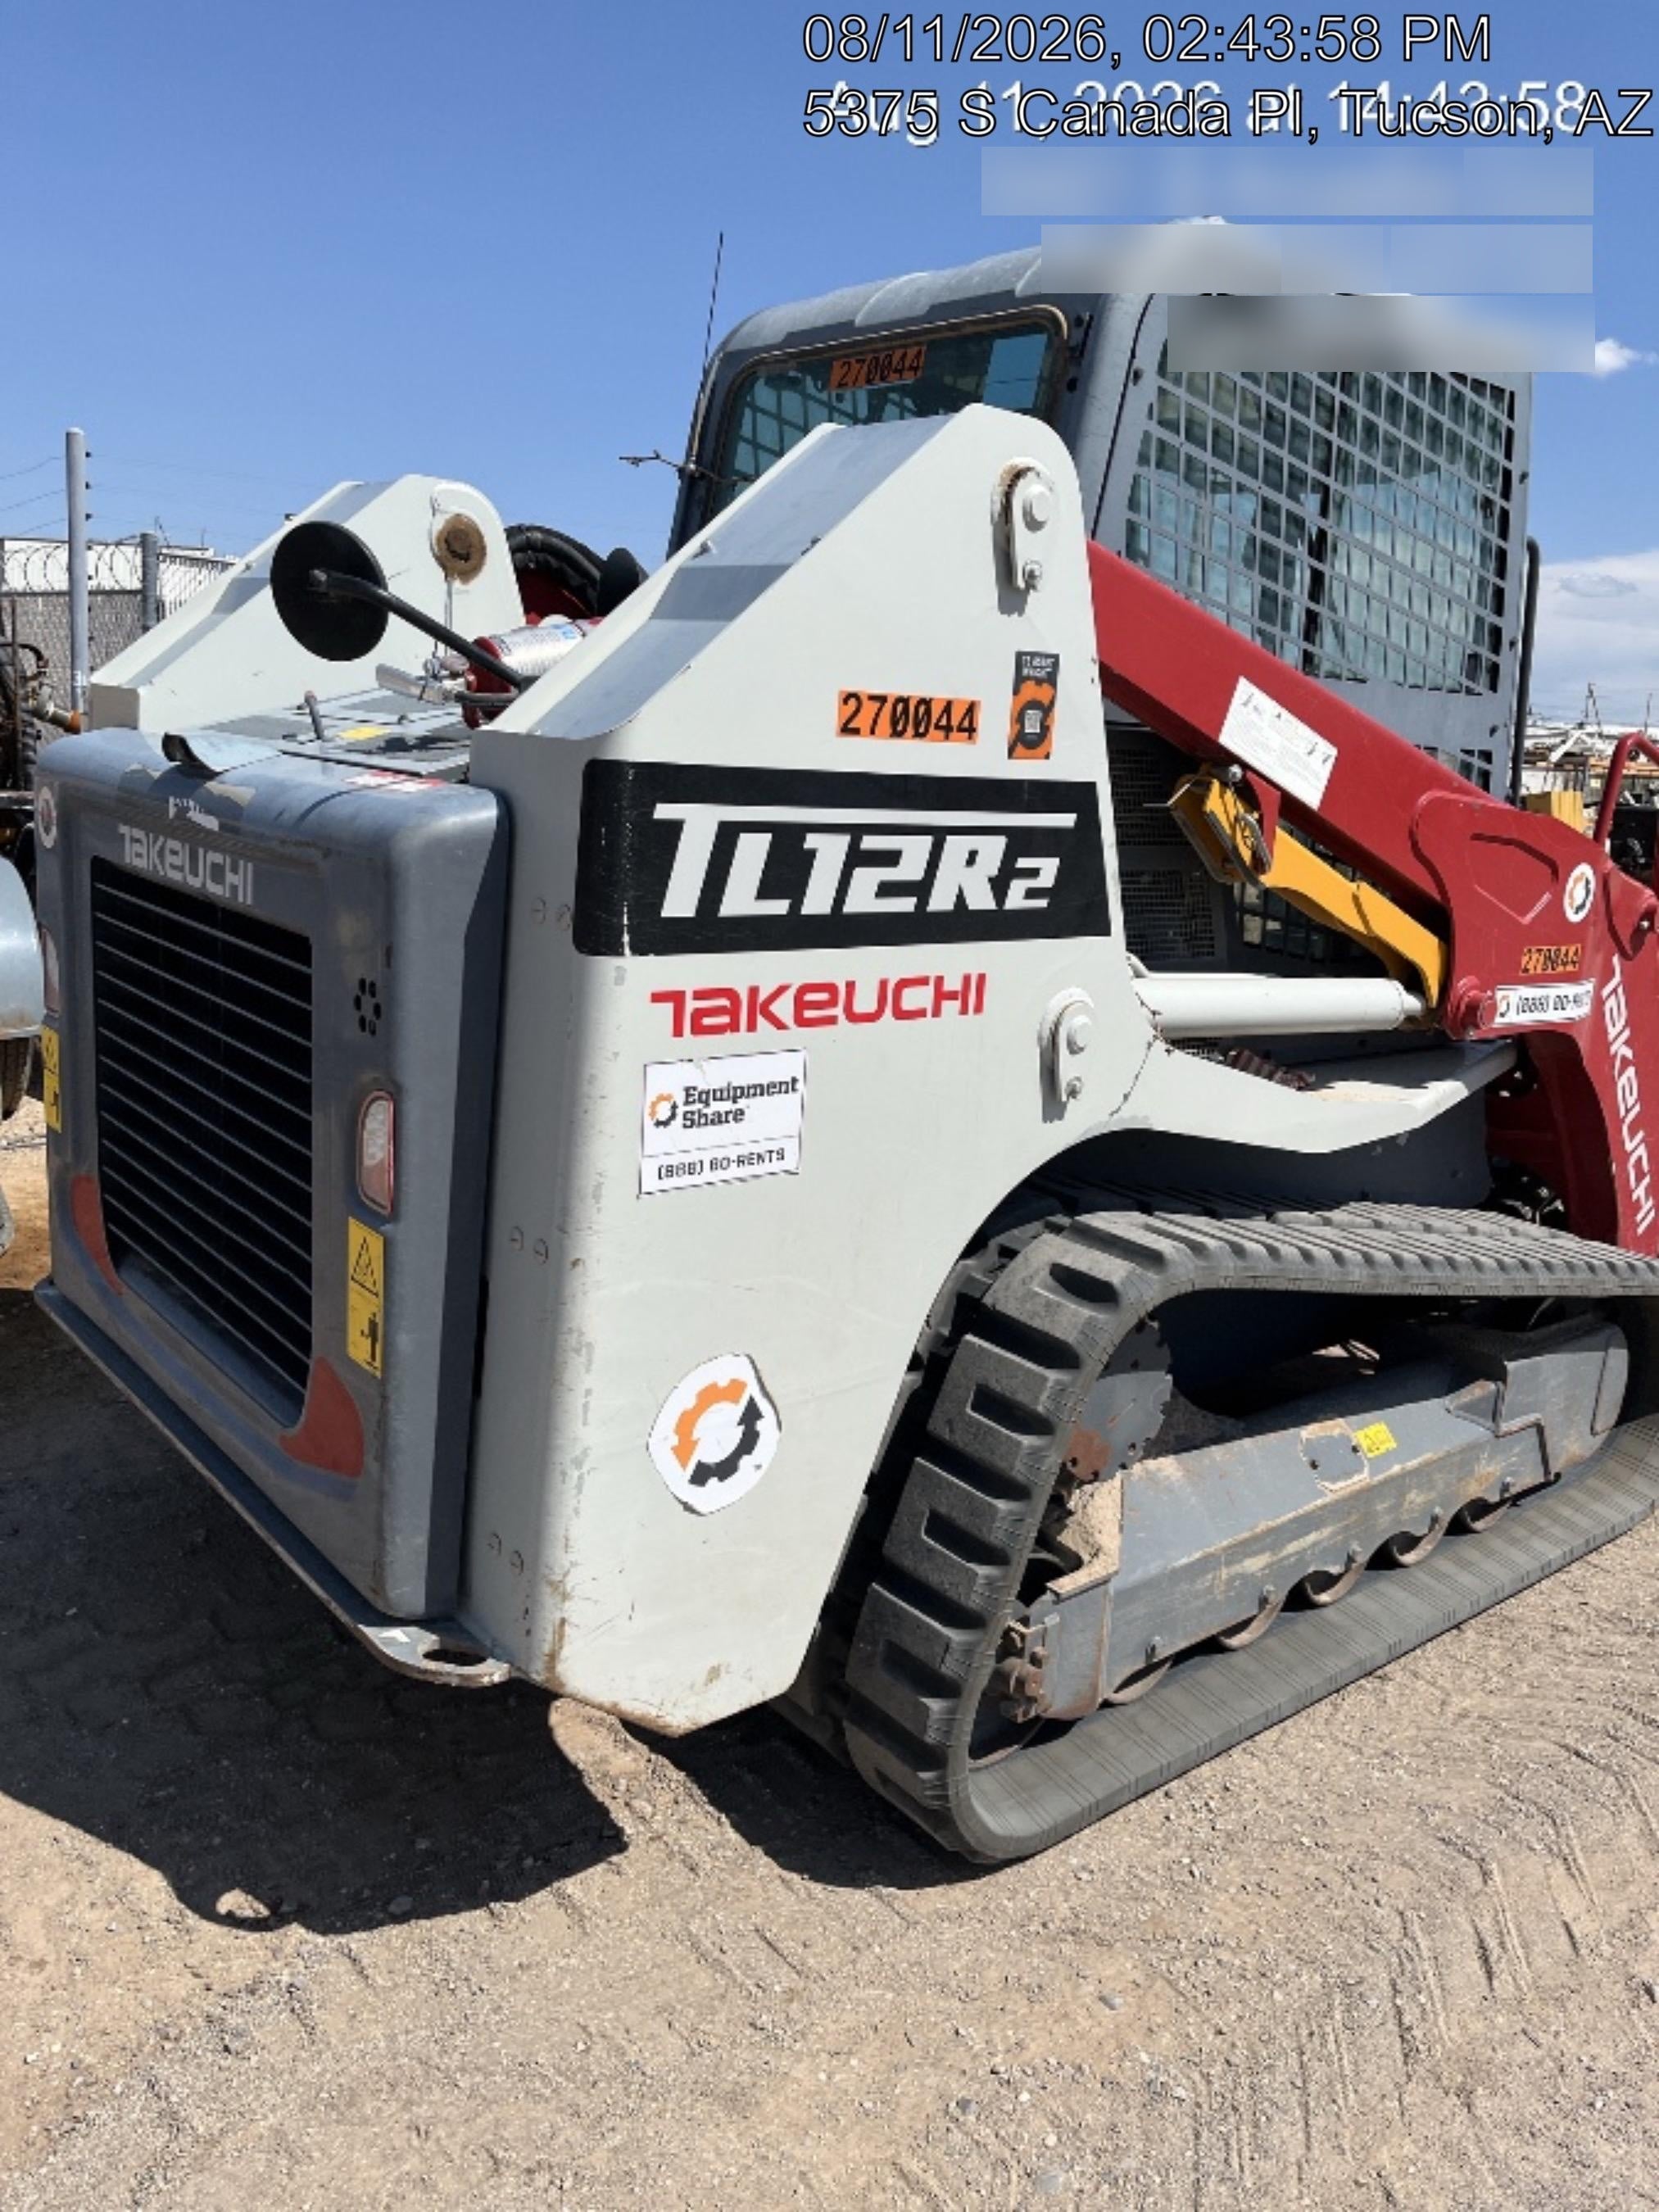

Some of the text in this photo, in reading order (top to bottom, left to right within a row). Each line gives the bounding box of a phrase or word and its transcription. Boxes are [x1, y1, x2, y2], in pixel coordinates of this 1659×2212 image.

[836, 347, 923, 388] 270044
[841, 691, 977, 741] 270044
[117, 823, 255, 906] TAKEUCHI
[652, 802, 1078, 918] TL12R2
[650, 972, 987, 1038] TAKEUCHI
[682, 1076, 800, 1108] Equipment
[682, 1108, 746, 1129] Share
[1601, 953, 1656, 1237] TAKEUCHI
